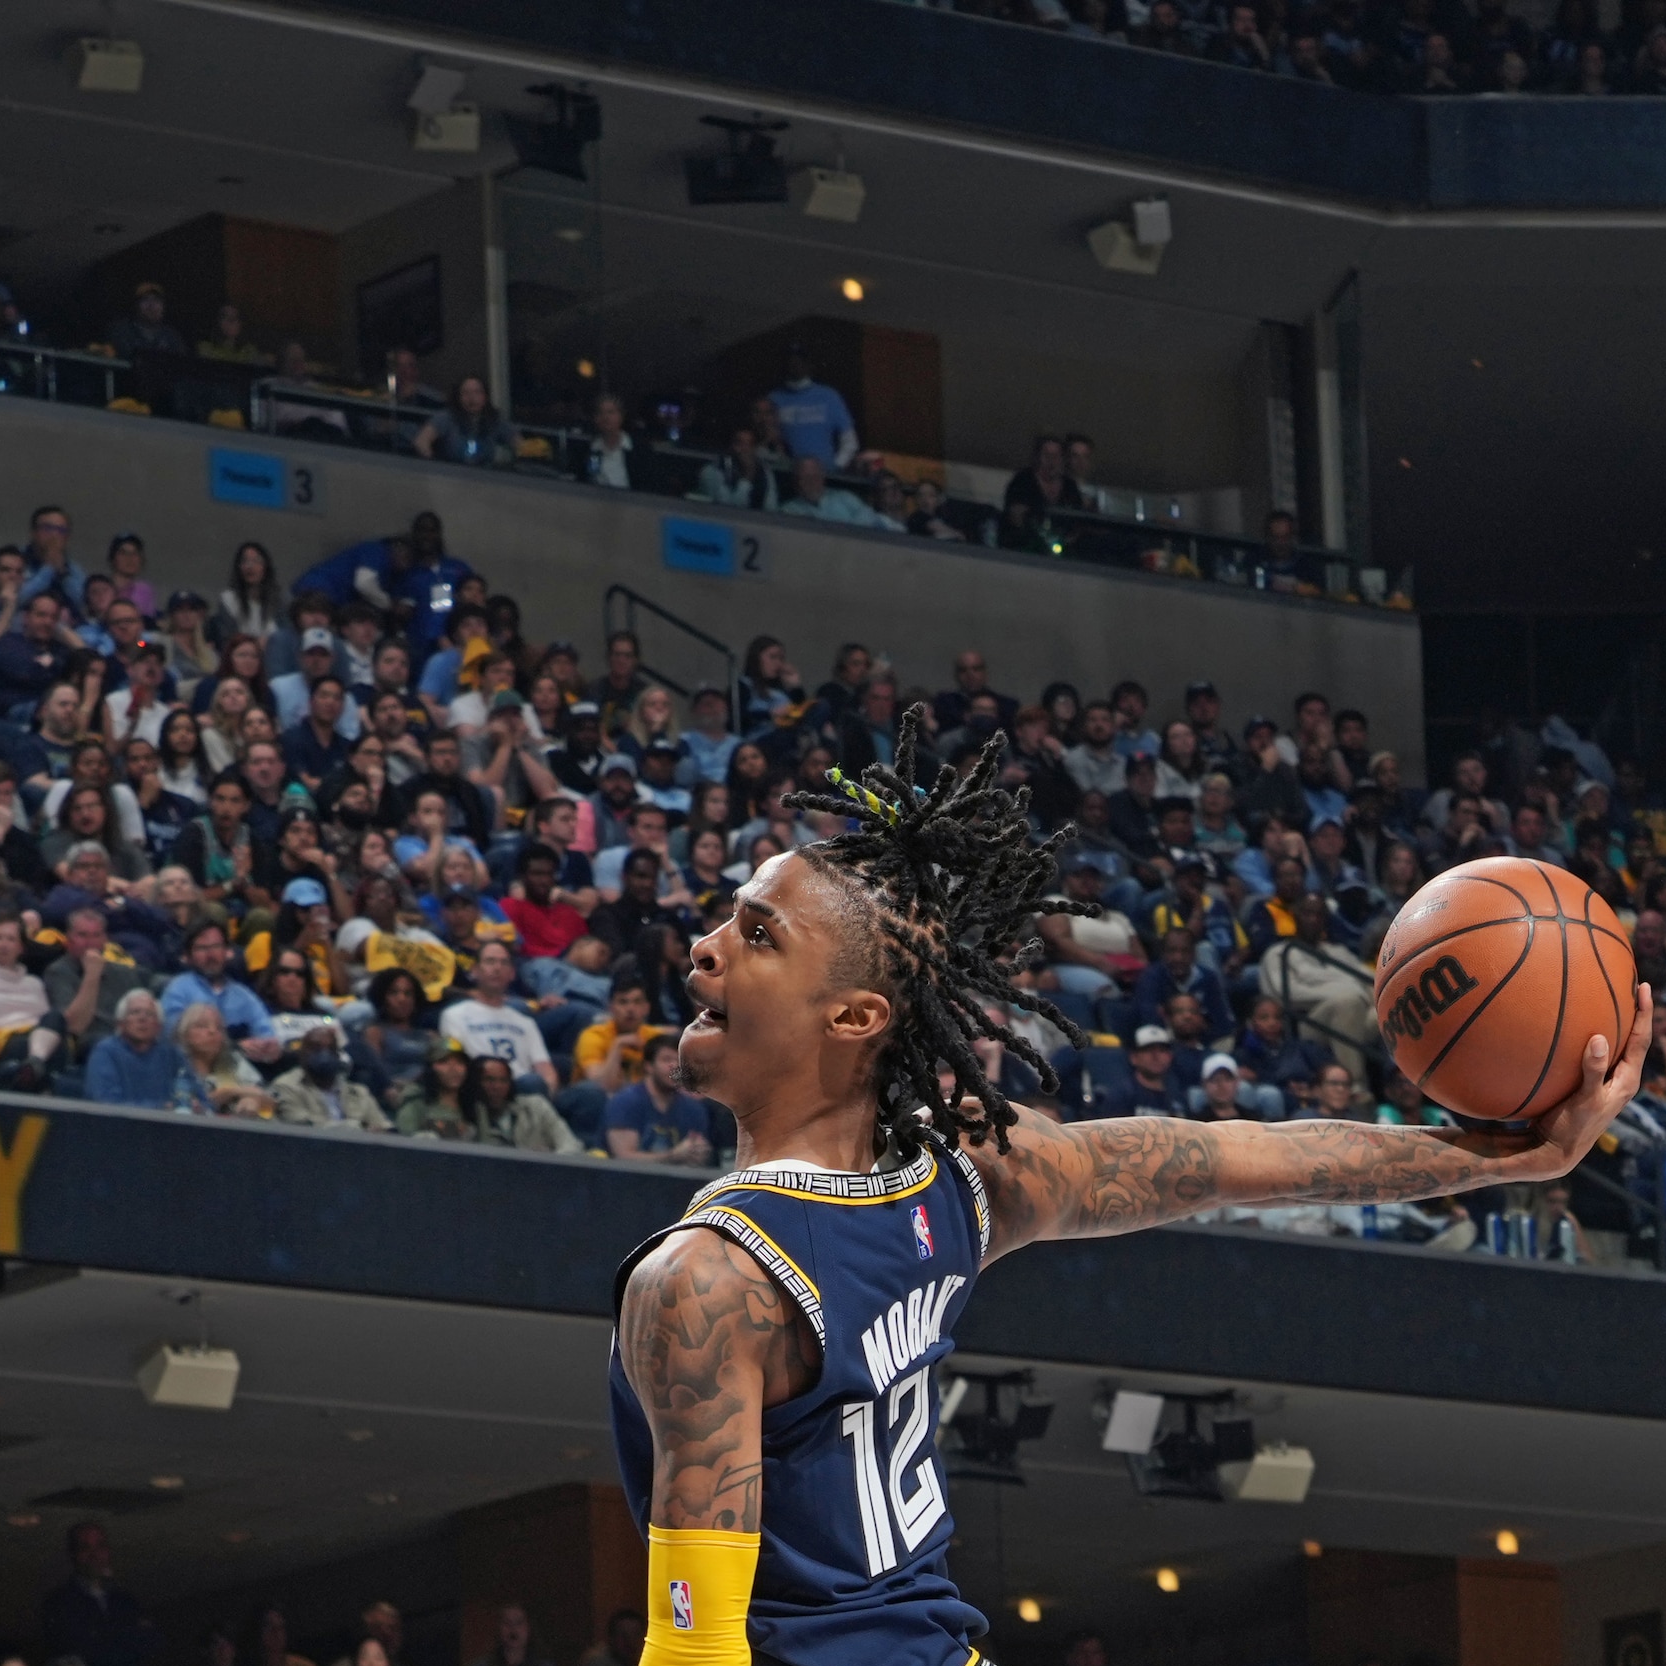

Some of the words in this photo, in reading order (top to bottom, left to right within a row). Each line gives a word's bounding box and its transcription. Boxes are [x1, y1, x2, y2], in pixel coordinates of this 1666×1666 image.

[294, 467, 314, 506] 3
[742, 536, 763, 573] 2
[1382, 953, 1480, 1054] Wilso
[861, 1275, 966, 1396] MORANT
[841, 1365, 947, 1578] 12
